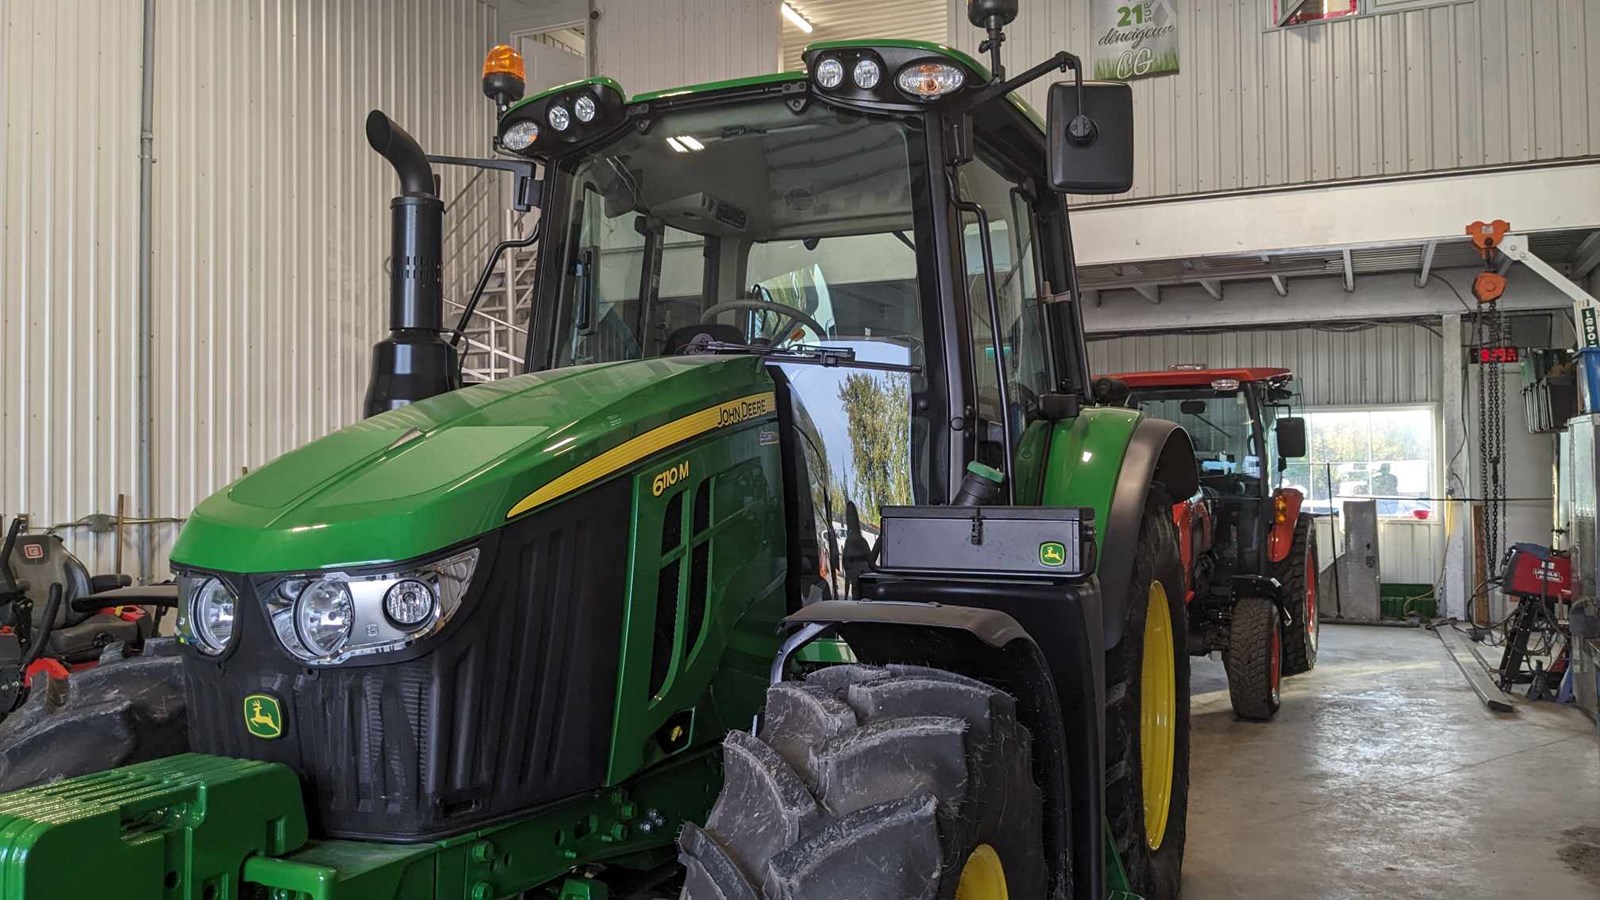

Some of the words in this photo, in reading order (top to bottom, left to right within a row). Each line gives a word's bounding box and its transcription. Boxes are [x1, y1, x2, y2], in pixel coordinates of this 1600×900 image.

[1117, 4, 1143, 27] 21
[1116, 47, 1154, 79] CG
[717, 404, 741, 426] JOHN
[741, 399, 766, 418] DEERE
